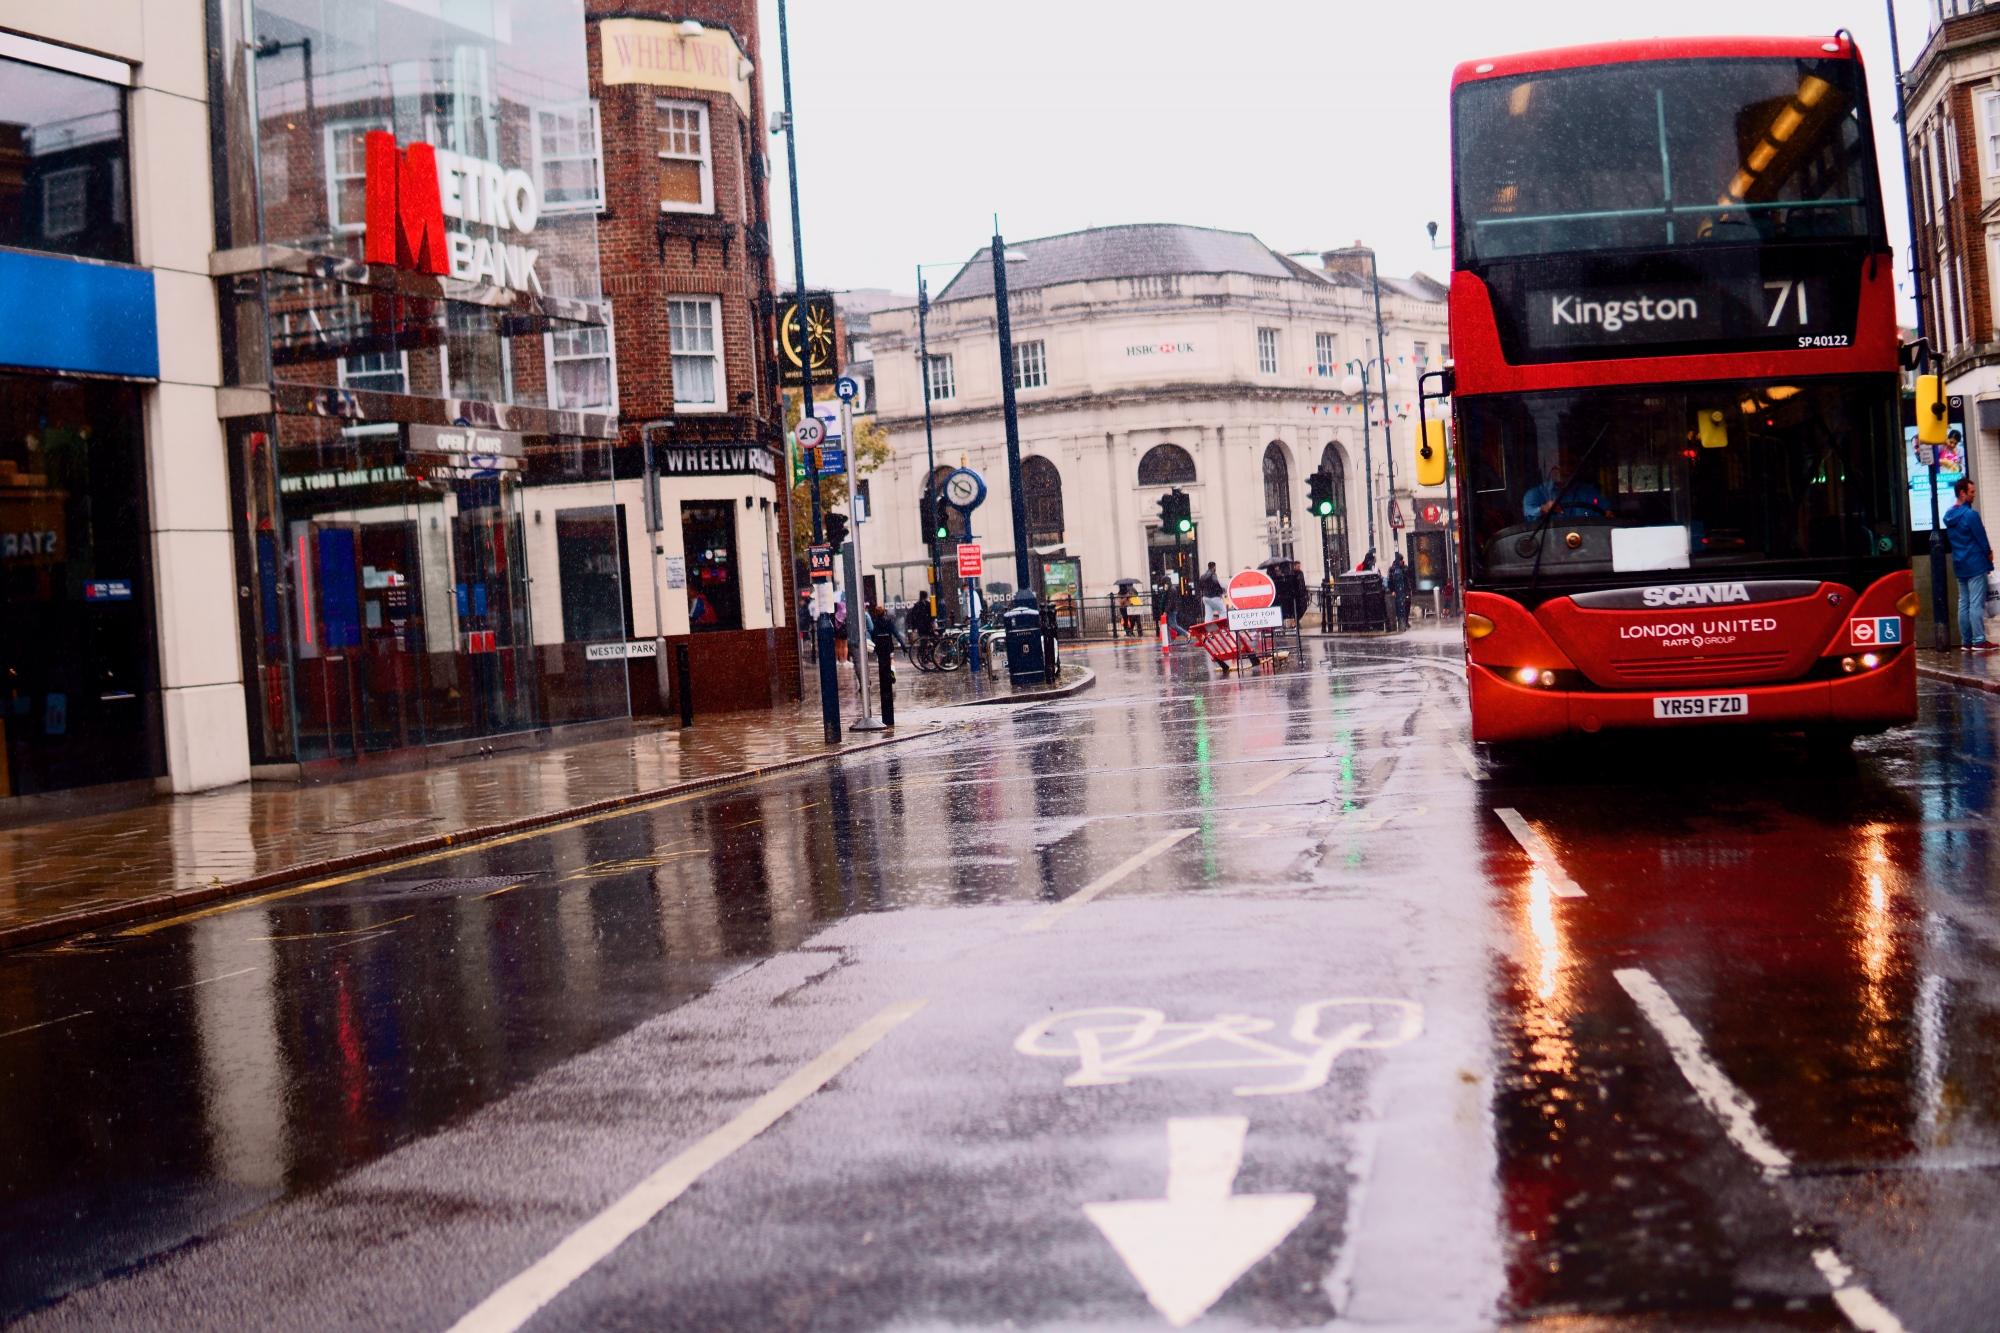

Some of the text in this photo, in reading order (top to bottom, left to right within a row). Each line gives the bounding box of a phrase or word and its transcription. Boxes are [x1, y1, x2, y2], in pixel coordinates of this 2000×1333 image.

[365, 130, 538, 276] METRO
[446, 231, 543, 299] BANK
[1552, 280, 1808, 331] Kingston 71
[1127, 342, 1194, 356] HSBC UK
[1798, 335, 1848, 347] SP40122
[437, 430, 501, 453] OPEN 7 DAYS
[799, 426, 818, 440] 20
[281, 477, 303, 493] OVE
[304, 474, 336, 490] YOUR
[338, 469, 369, 486] BANK
[371, 468, 384, 482] AT
[1643, 584, 1749, 606] SCANIA
[1620, 618, 1777, 638] LONDON UNITED
[590, 644, 656, 656] WESTON PARK
[1663, 636, 1736, 647] RATP GROUP
[1661, 697, 1741, 715] YR59 FZD
